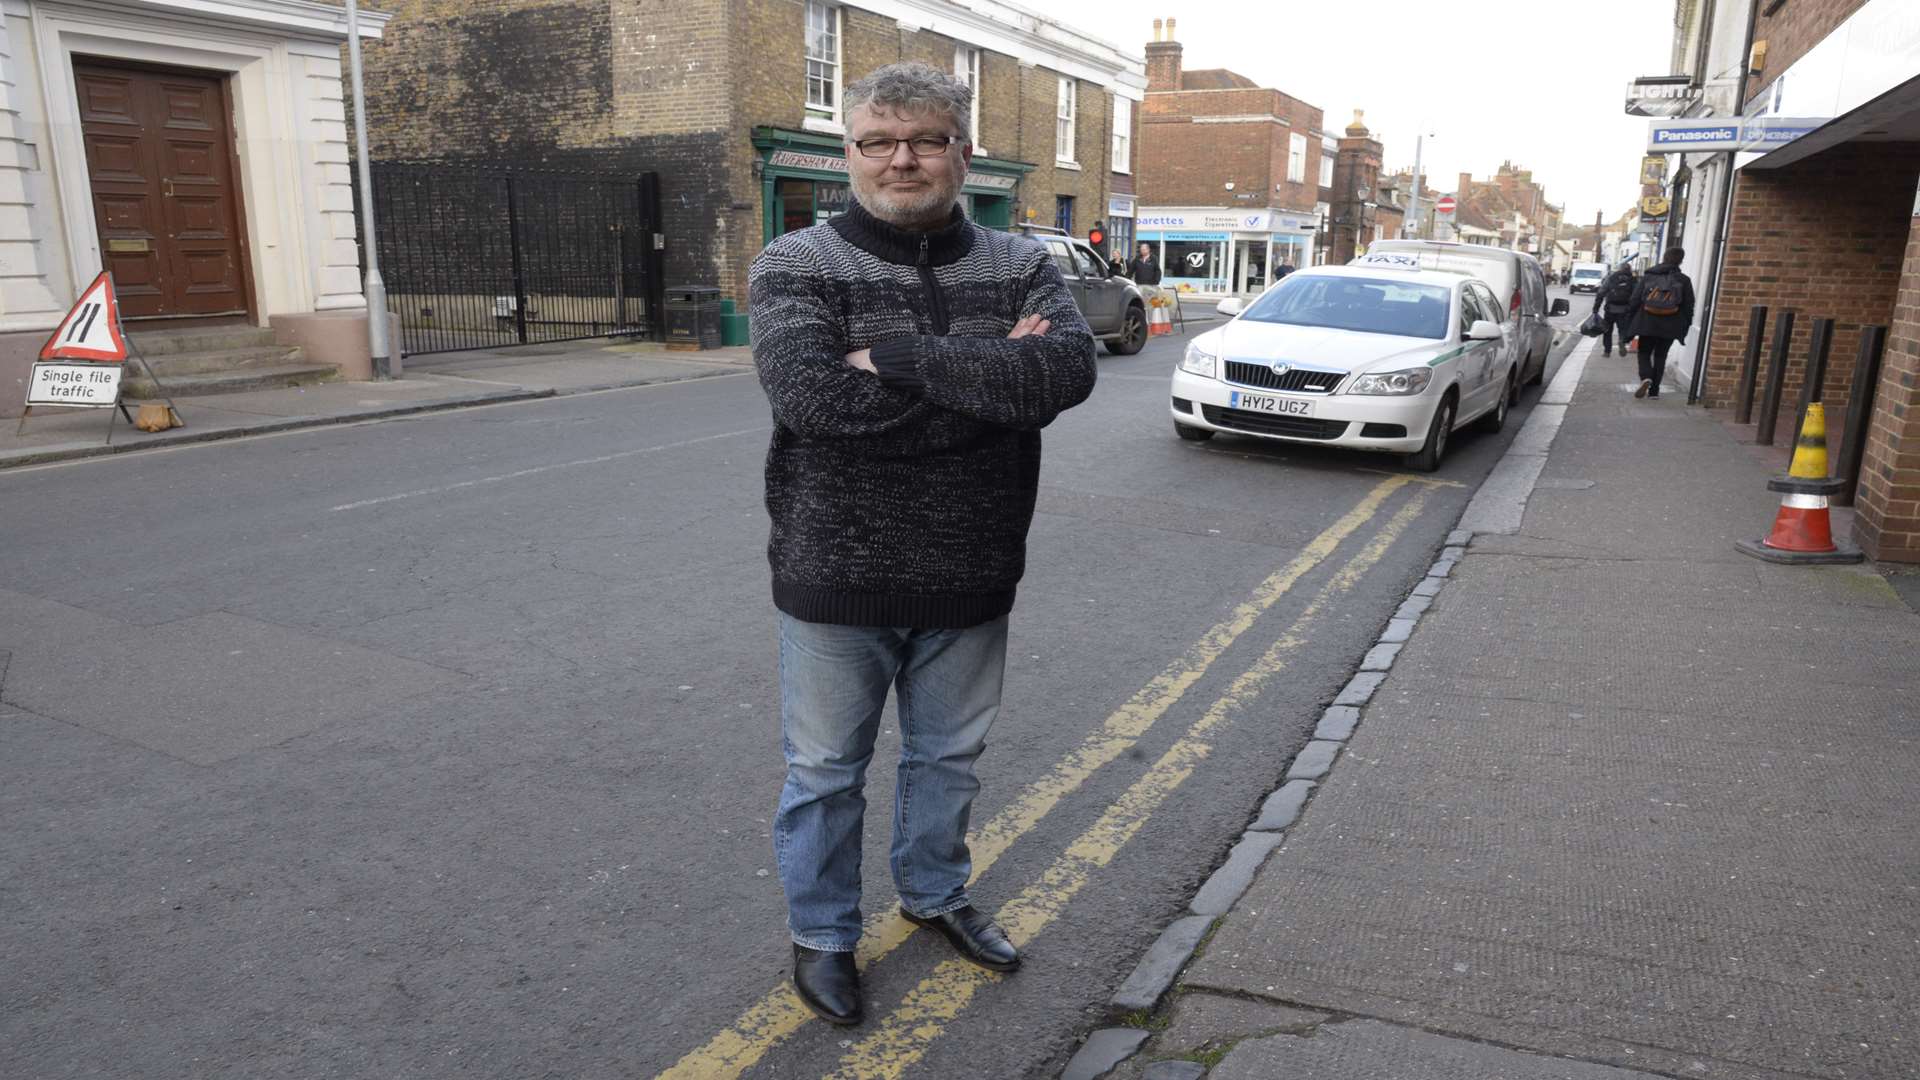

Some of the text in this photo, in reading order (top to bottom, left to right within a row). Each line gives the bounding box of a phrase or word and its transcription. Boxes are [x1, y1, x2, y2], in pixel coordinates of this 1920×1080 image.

[1658, 128, 1732, 142] Panasonic
[1367, 254, 1417, 266] TAXI
[42, 370, 112, 384] Single file
[51, 385, 95, 397] traffic
[1242, 395, 1310, 415] HY12 UGZ
